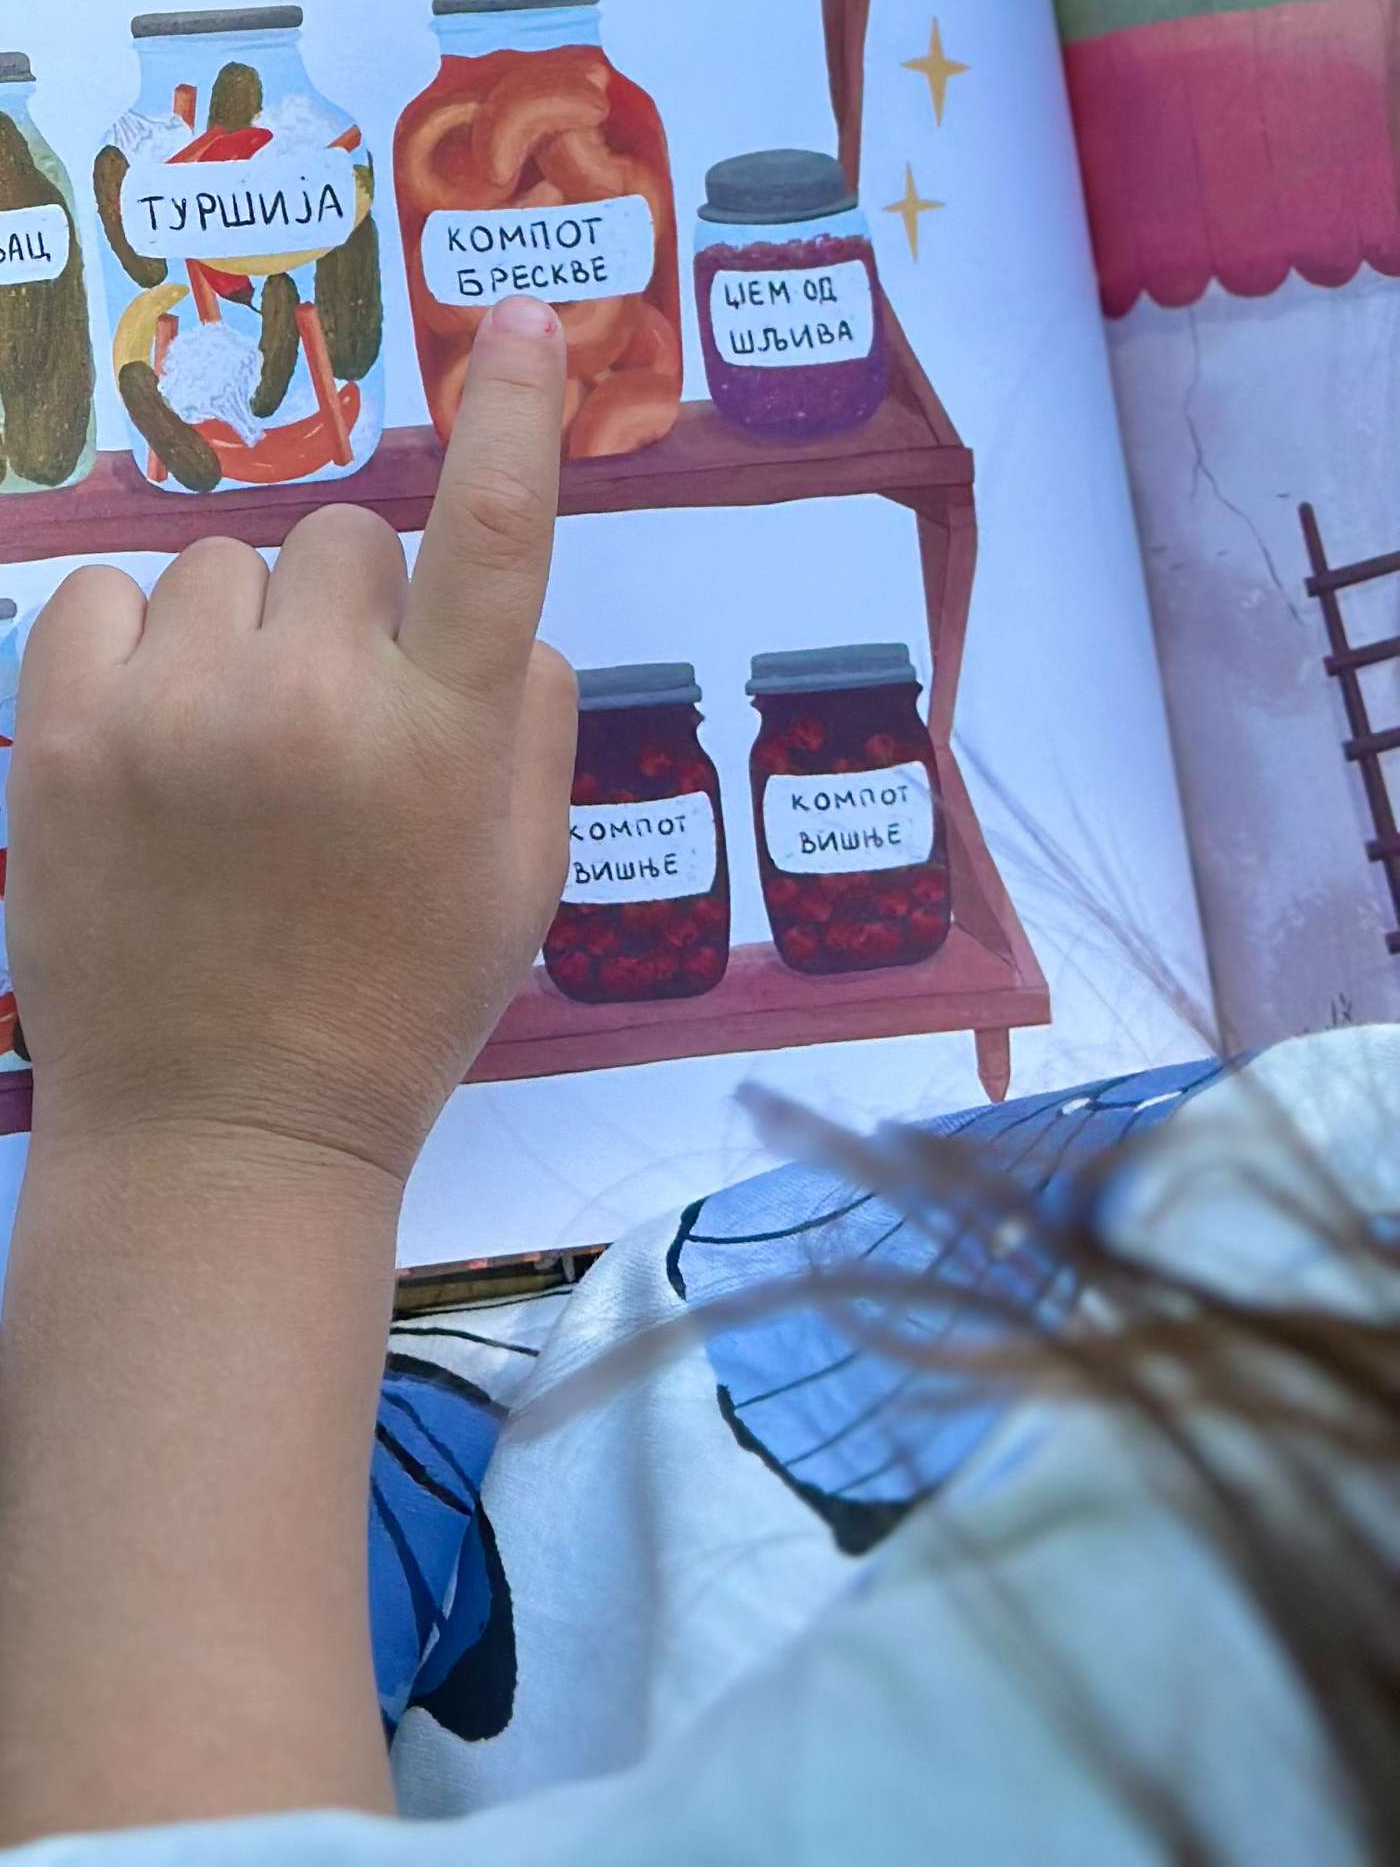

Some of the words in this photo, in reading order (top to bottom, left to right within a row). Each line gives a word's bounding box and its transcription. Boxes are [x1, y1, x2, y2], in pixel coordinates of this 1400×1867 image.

[140, 176, 343, 230] ТУРШИЈА
[448, 217, 602, 252] КОМПОТ
[457, 256, 607, 296] БРЕСКВЕ
[725, 281, 790, 309] ЏЕМ
[804, 277, 837, 304] ОД
[730, 320, 853, 354] ШЉИВА
[792, 786, 907, 811] КОМПОТ
[800, 823, 901, 854] ВИШЊЕ
[574, 853, 677, 884] ВИШЊЕ
